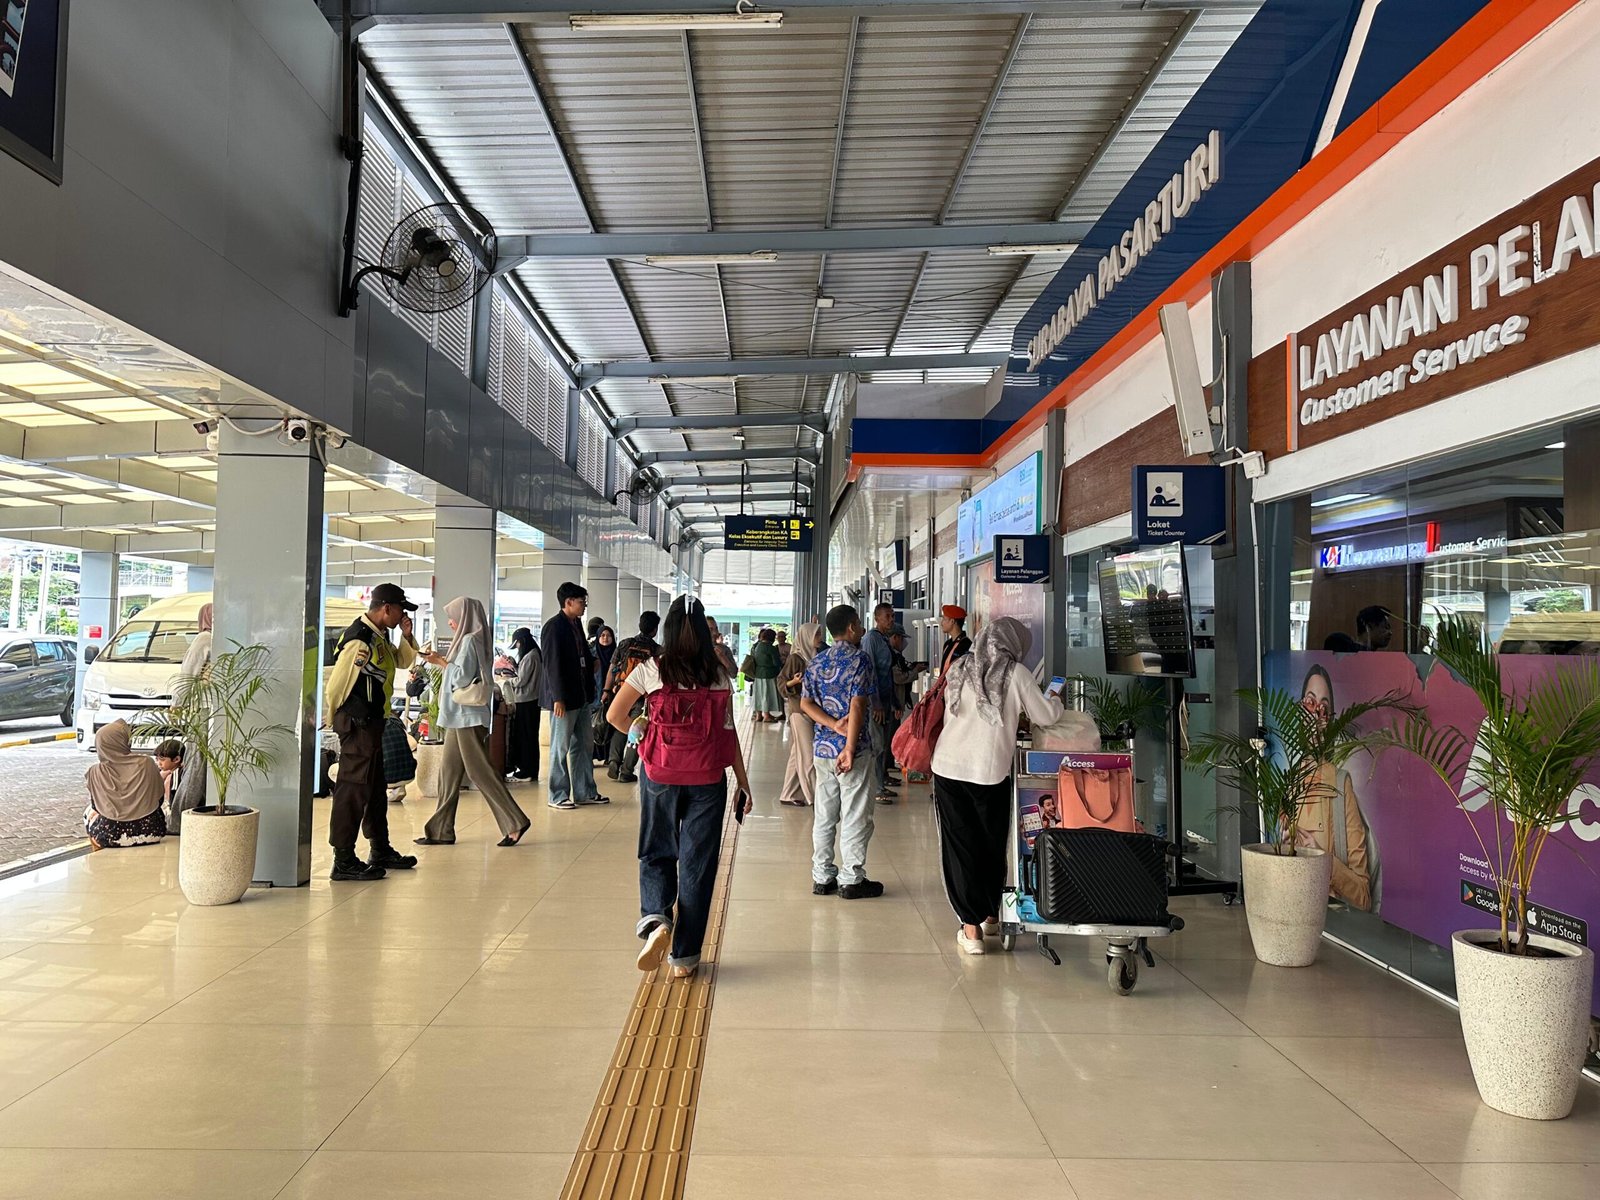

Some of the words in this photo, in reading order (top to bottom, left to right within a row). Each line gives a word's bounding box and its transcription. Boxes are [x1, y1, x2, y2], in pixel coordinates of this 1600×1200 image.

[1027, 273, 1097, 372] SURABAYA
[1098, 129, 1219, 300] PASARTURI
[1300, 264, 1458, 391] LAYANAN
[1300, 364, 1411, 426] Customer
[1409, 314, 1530, 384] Service
[781, 520, 786, 529] 1
[1435, 541, 1474, 554] Customer
[1061, 755, 1095, 768] Access
[1459, 852, 1489, 869] Download
[1459, 863, 1480, 877] Access
[1480, 869, 1489, 881] by
[1475, 894, 1498, 912] Google
[1540, 910, 1565, 924] Download
[1572, 921, 1581, 931] the
[1540, 918, 1558, 936] App
[1558, 924, 1582, 943] Store
